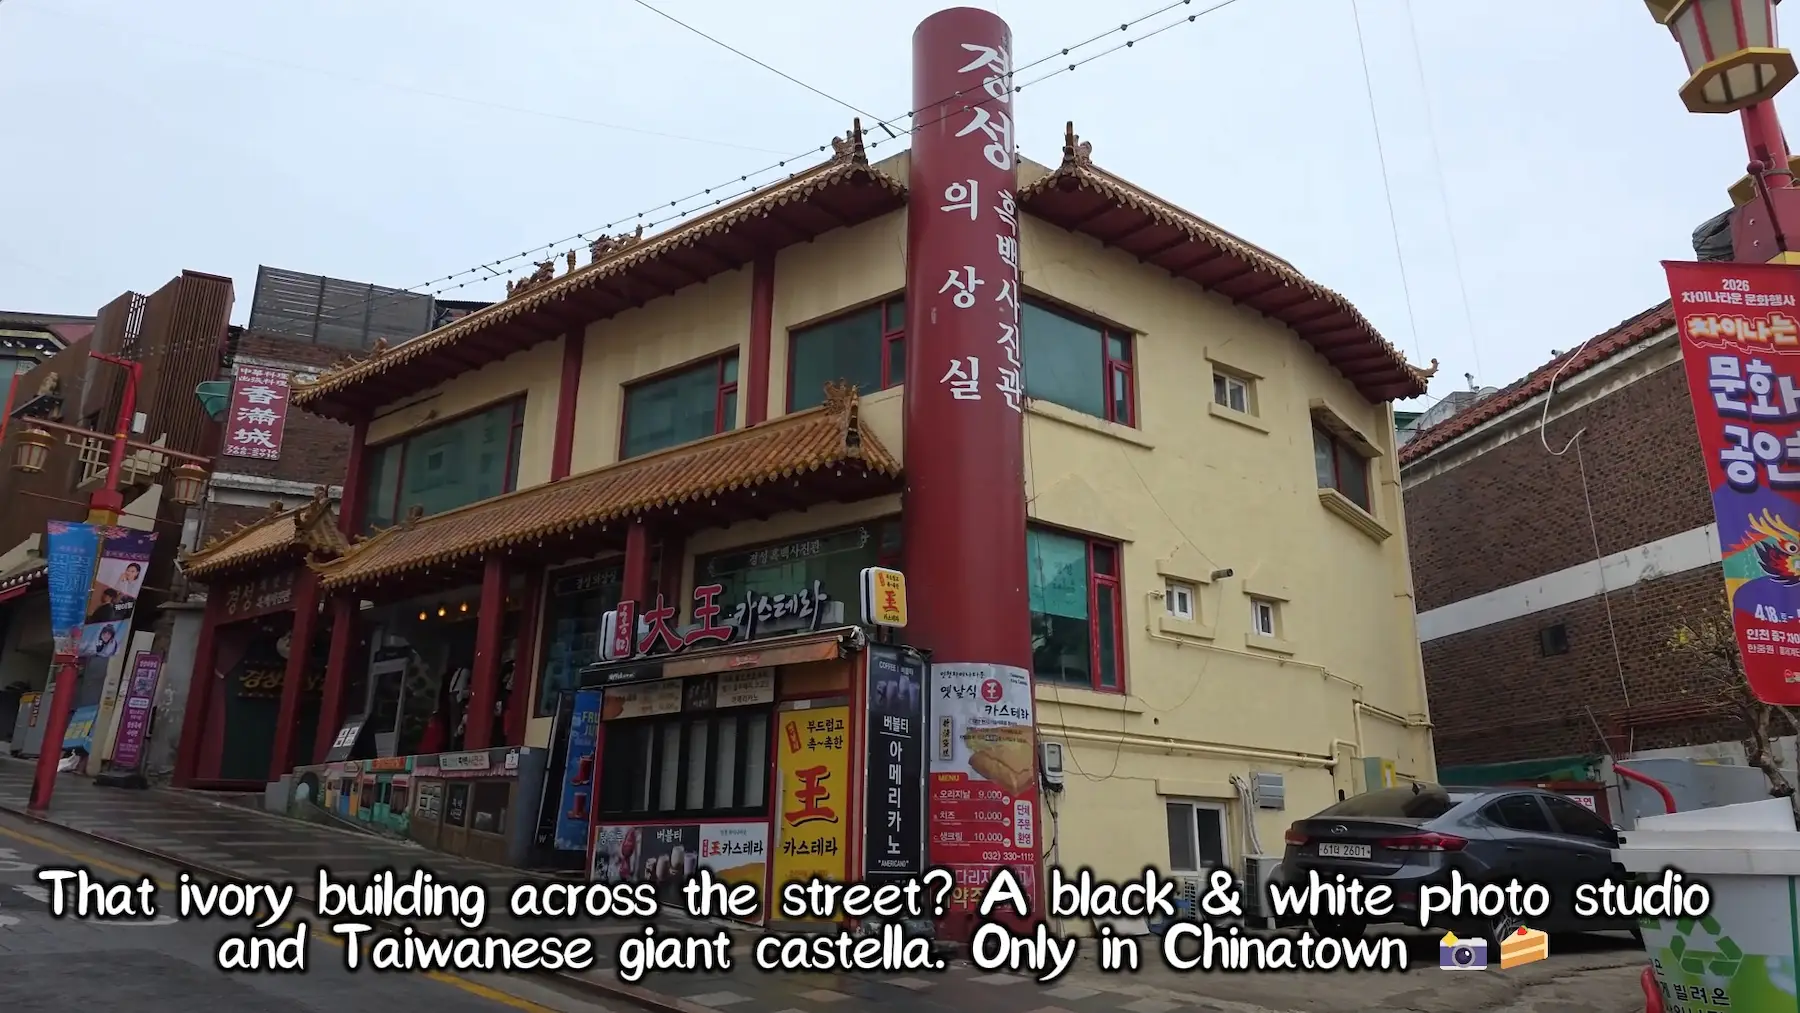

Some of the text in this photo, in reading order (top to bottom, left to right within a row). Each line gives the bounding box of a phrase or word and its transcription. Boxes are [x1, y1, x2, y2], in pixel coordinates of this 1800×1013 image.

[954, 43, 1015, 171] 경성
[938, 178, 985, 401] 의상실
[1721, 278, 1751, 292] 2026
[993, 188, 1024, 413] 흑백사진관
[1680, 290, 1796, 307] 차이나타운 문화행사
[1687, 314, 1799, 346] 차이나는
[733, 579, 828, 641] 카스테라
[638, 582, 733, 655] 大王
[1746, 628, 1771, 641] 인천
[878, 660, 897, 672] COFFEE
[940, 684, 977, 699] 옛날식
[984, 704, 1030, 721] 카스테라
[806, 717, 845, 732] 부드럽고
[882, 714, 910, 734] 버블티
[937, 773, 960, 782] MENU
[784, 764, 839, 828] 王
[886, 739, 905, 855] 아메리카노
[939, 810, 956, 820] 치즈
[1016, 804, 1030, 817] 단체
[1016, 818, 1031, 831] 주문
[656, 828, 683, 843] 버블티
[939, 832, 963, 842] 생크림
[1017, 832, 1031, 845] 환영
[721, 839, 764, 856] 카스테라
[783, 837, 839, 857] 카스테라
[1343, 845, 1366, 857] 2601
[982, 850, 1002, 862] 032)
[1672, 983, 1733, 1008] 빌려온
